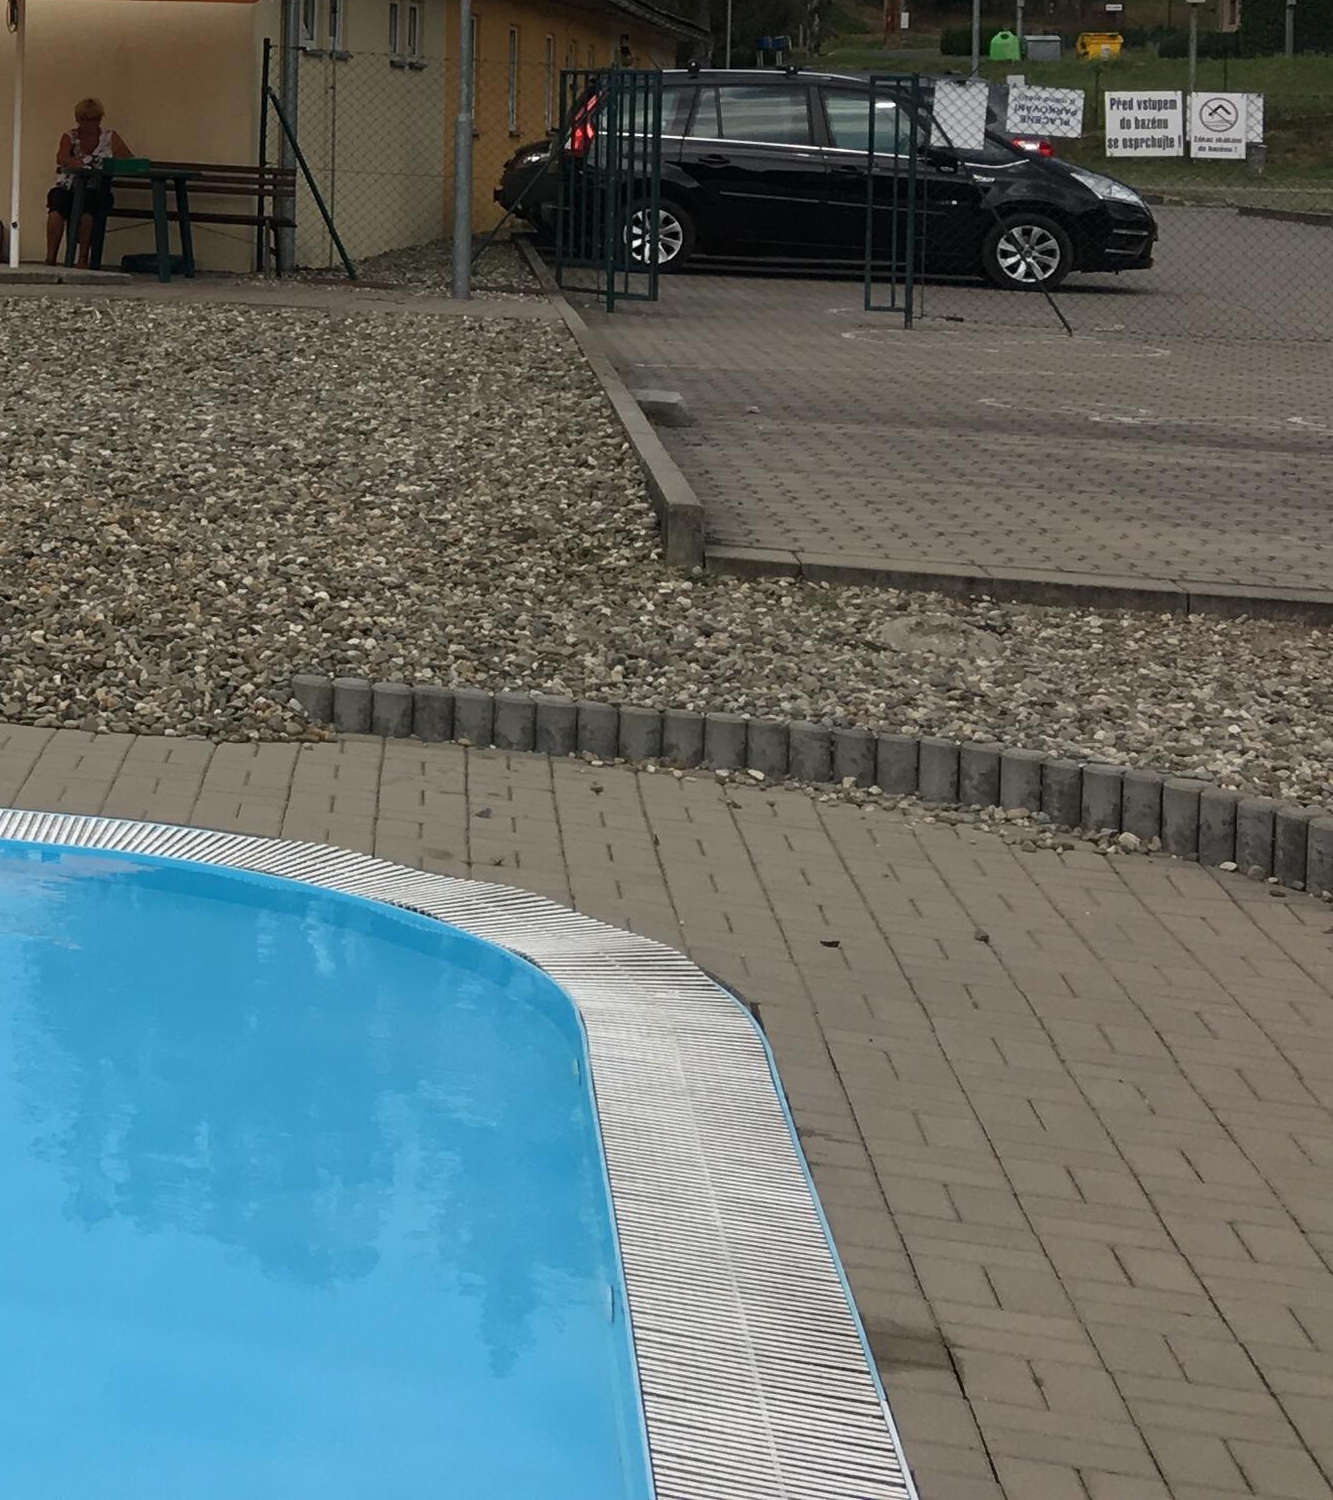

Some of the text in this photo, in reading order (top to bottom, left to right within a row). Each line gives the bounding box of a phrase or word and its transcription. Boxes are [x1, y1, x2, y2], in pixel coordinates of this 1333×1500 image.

[1109, 97, 1177, 112] Před vstupem
[1119, 116, 1169, 130] do bazénu
[1107, 137, 1120, 149] se
[1122, 135, 1175, 151] osprchujte
